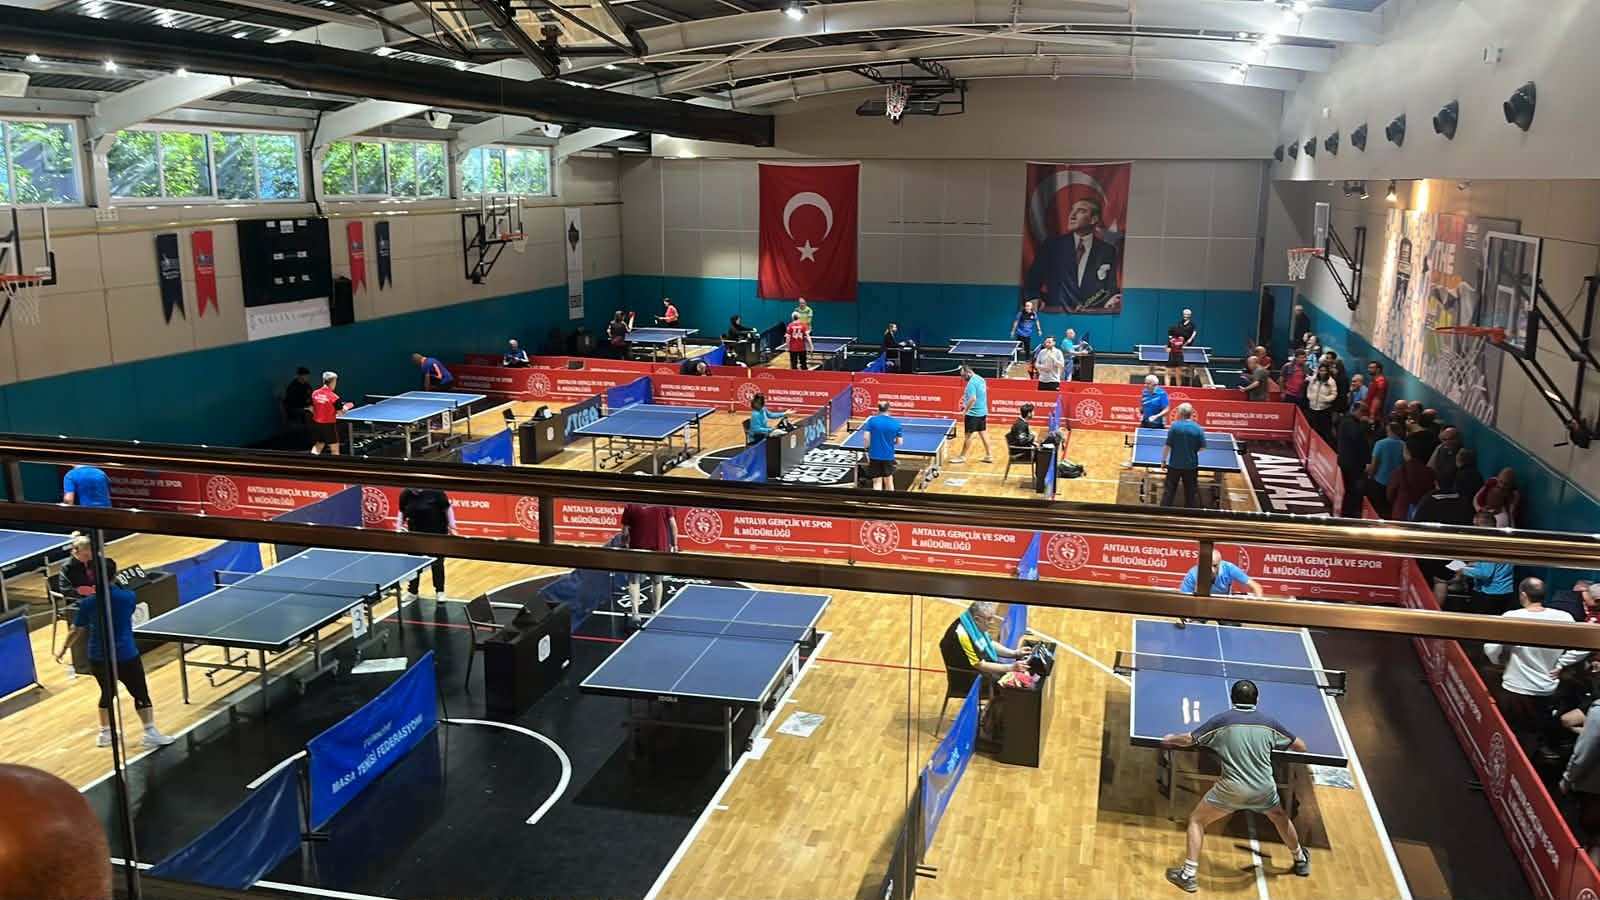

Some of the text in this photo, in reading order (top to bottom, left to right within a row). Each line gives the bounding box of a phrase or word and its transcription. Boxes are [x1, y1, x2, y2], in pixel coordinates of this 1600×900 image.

[1250, 452, 1328, 516] ANTAL
[461, 499, 470, 508] VE
[471, 500, 490, 509] SPOR
[562, 504, 593, 513] ANTALYA
[734, 516, 833, 529] ANTALYA GENÇLİK VE SPOR
[742, 527, 791, 538] MÜDÜRLÜĞÜ
[911, 527, 1016, 544] ANTALYA GENÇLİK VE SPOR
[920, 538, 972, 551] MÜDÜRLÜĞÜ
[1102, 543, 1140, 554] ANTALYA
[1141, 545, 1179, 558] GENÇLİK
[1179, 548, 1191, 558] VE
[1111, 554, 1168, 569] MÜDÜRLÜĞÜ
[1263, 553, 1383, 569] ANTALYA GENÇLİK VE SPOR
[1263, 564, 1331, 579] İL MÜDÜRLÜĞÜ
[331, 771, 356, 794] MASA
